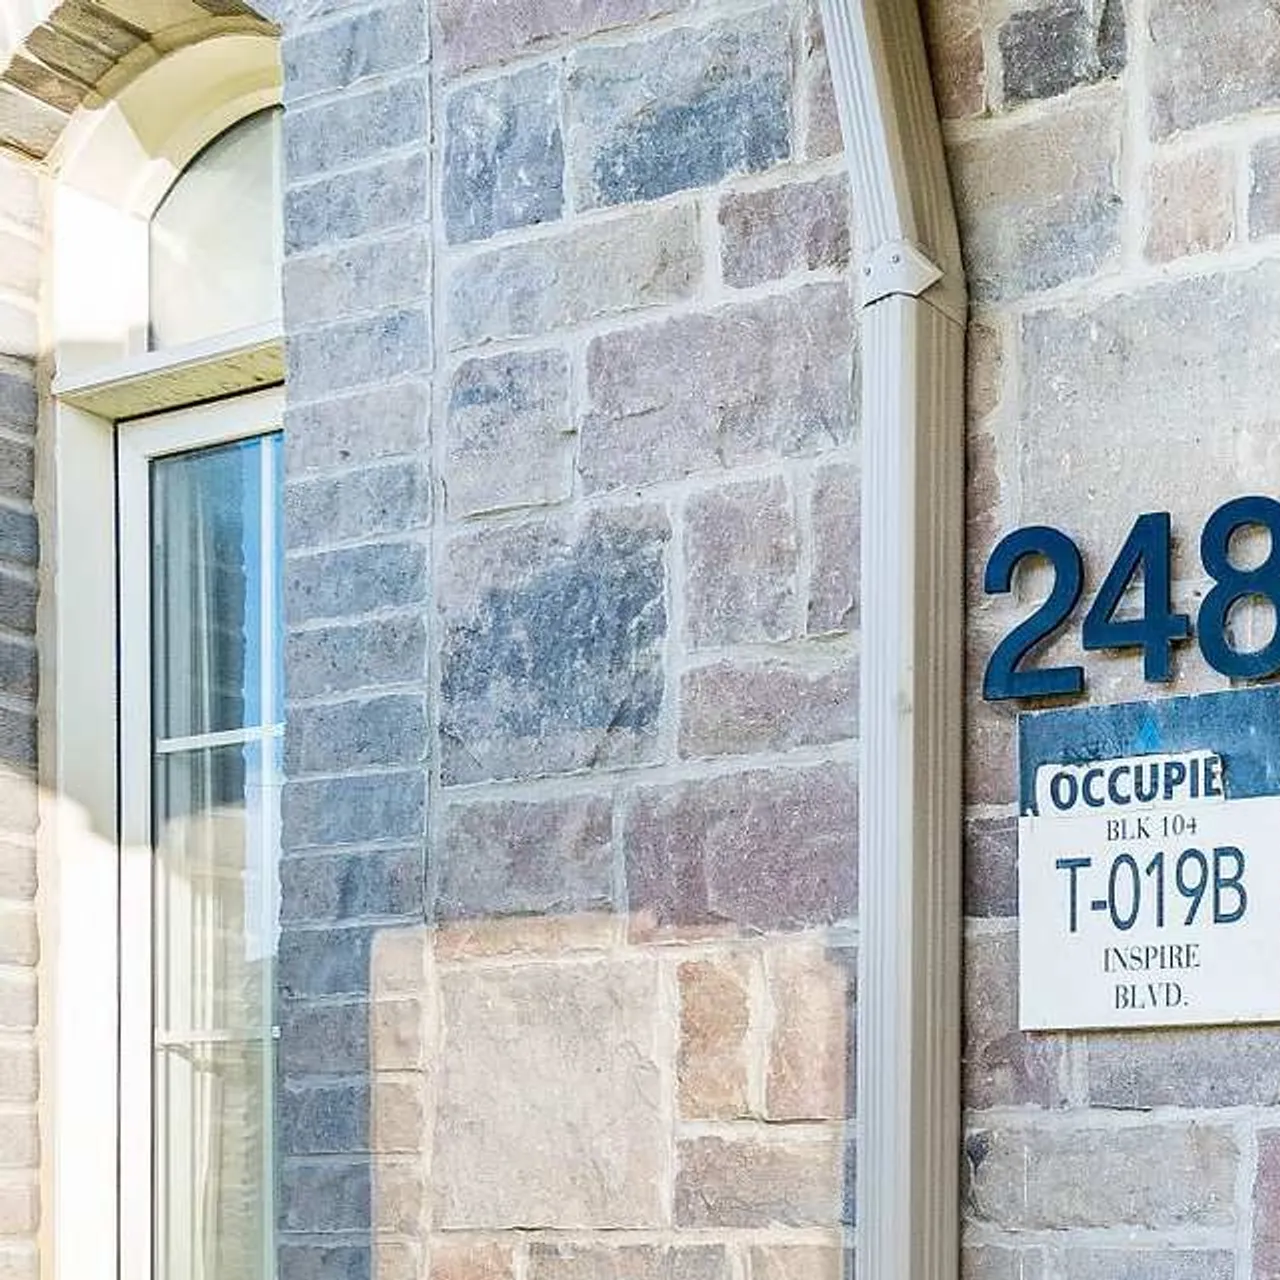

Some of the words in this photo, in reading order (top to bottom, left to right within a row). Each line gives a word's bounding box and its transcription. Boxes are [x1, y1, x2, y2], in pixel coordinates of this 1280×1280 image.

[1106, 817, 1151, 841] BLK
[1161, 814, 1198, 837] 104
[1055, 845, 1248, 933] T-019B
[1103, 943, 1201, 972] INSPIRE
[1114, 981, 1190, 1009] BLVD.
